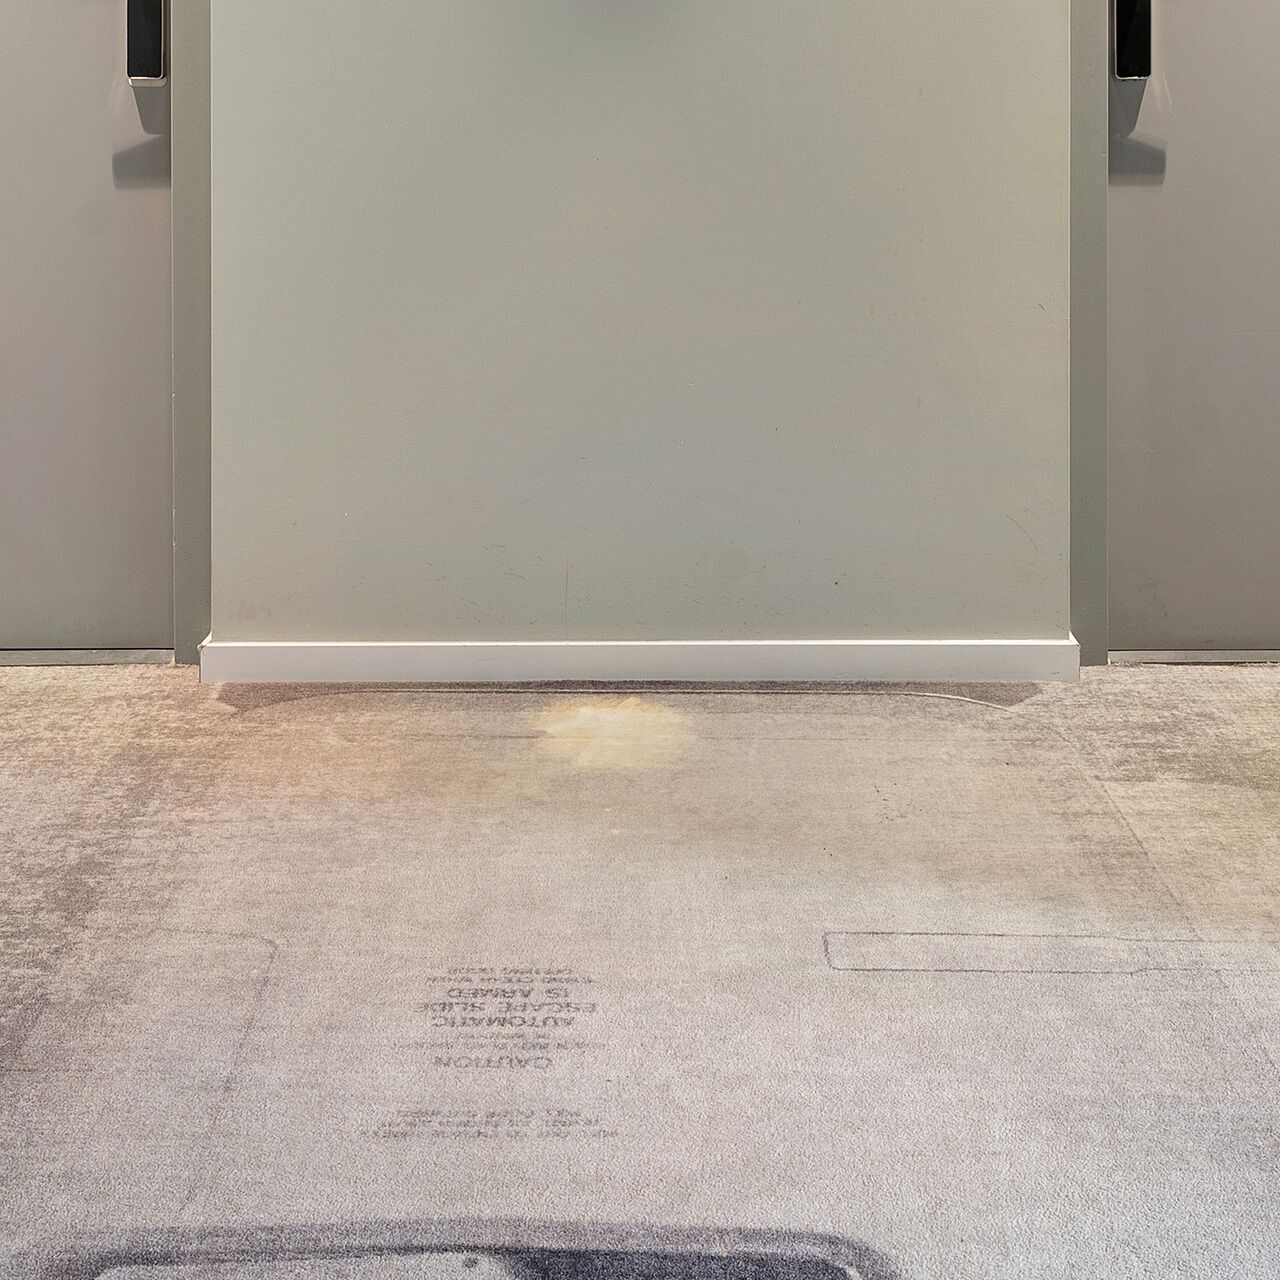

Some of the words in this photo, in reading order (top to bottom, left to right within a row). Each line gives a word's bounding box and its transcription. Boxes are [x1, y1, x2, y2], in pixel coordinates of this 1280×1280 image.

[447, 988, 534, 999] ARMED
[545, 988, 568, 999] IS
[498, 1002, 597, 1013] ESCAPE
[431, 1016, 575, 1028] AUTOMATIC
[433, 1056, 554, 1069] CAUTION
